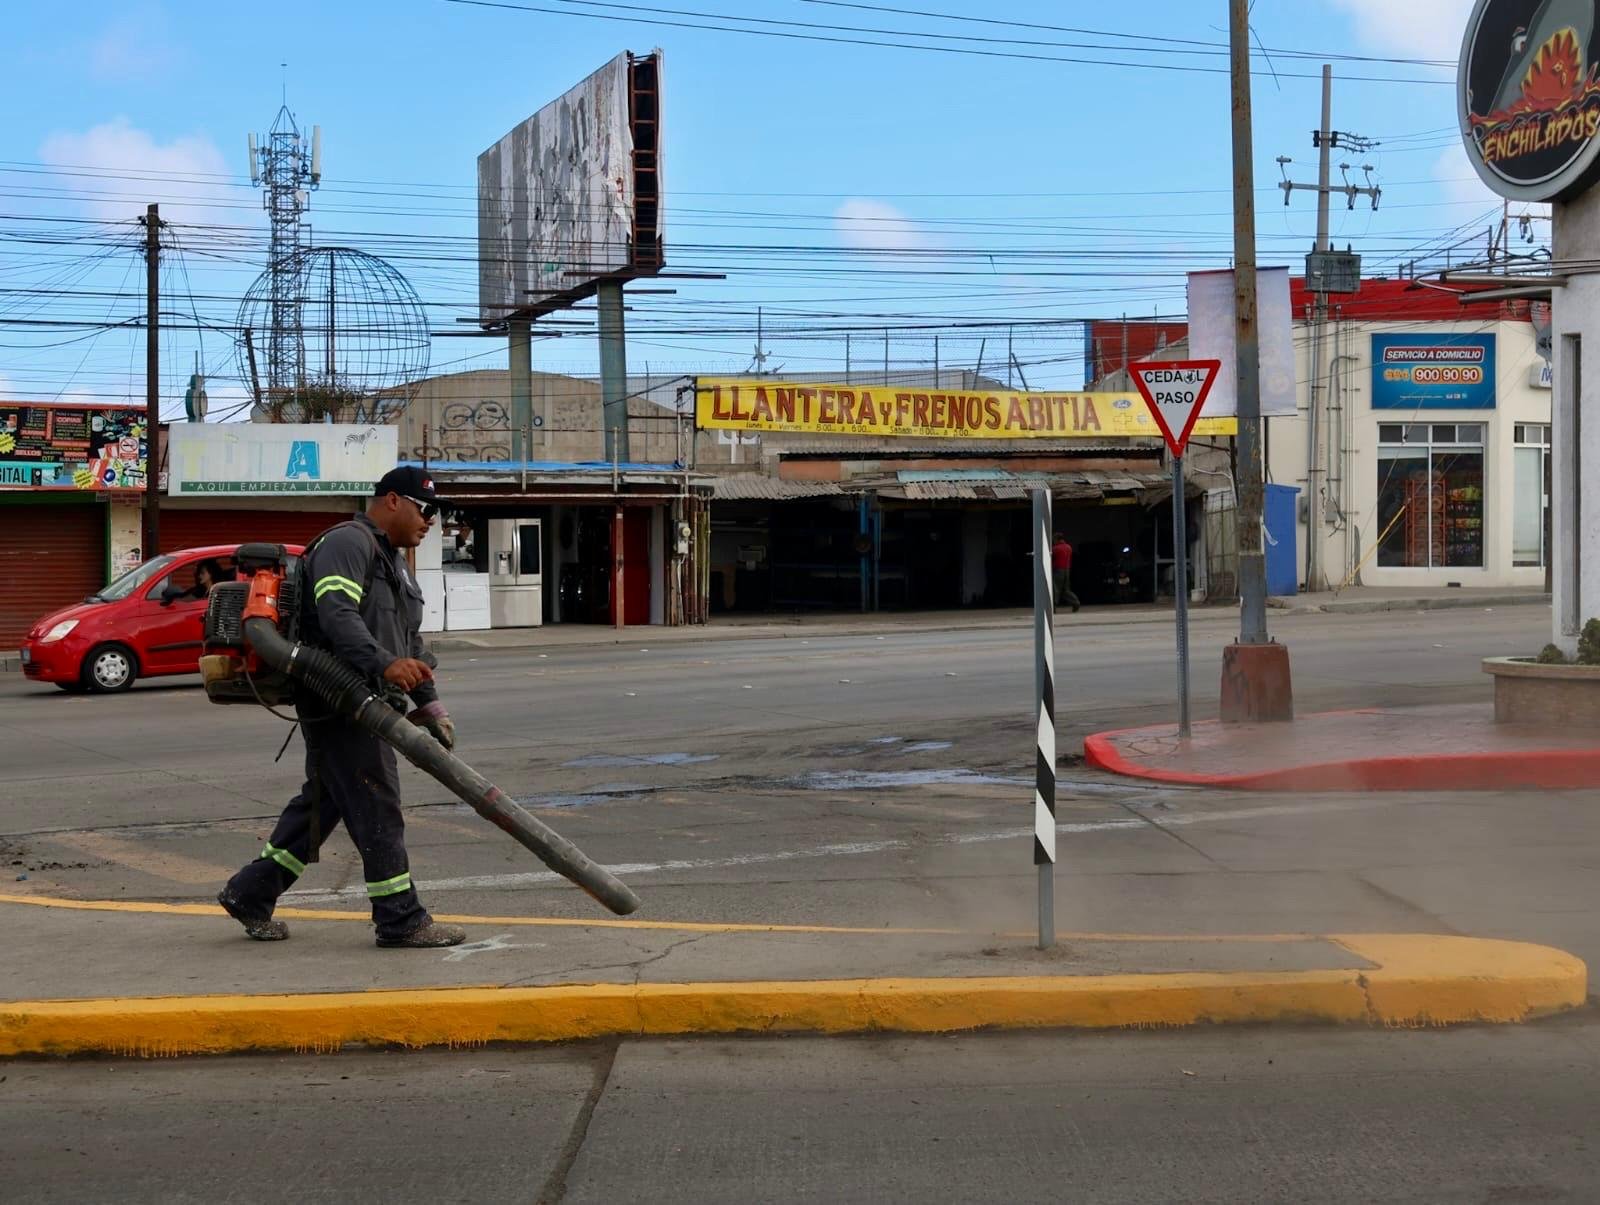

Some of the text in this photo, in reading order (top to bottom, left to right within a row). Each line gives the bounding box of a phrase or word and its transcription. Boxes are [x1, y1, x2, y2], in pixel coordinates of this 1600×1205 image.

[1483, 107, 1600, 162] ENCHILADOS
[1386, 350, 1481, 359] SERVICIO A DOMICILIO
[1144, 371, 1183, 383] CEDA
[1415, 369, 1440, 381] 900
[1442, 369, 1459, 381] 90
[1461, 369, 1478, 381] 90
[1156, 391, 1194, 404] PASO
[711, 385, 877, 424] LLANTERA
[895, 393, 1002, 430] FRENOS
[1005, 396, 1102, 431] ABITIA
[0, 467, 27, 483] ITAL
[240, 482, 297, 492] EMPIEZA
[306, 482, 321, 492] LA
[331, 482, 375, 492] PATRIA
